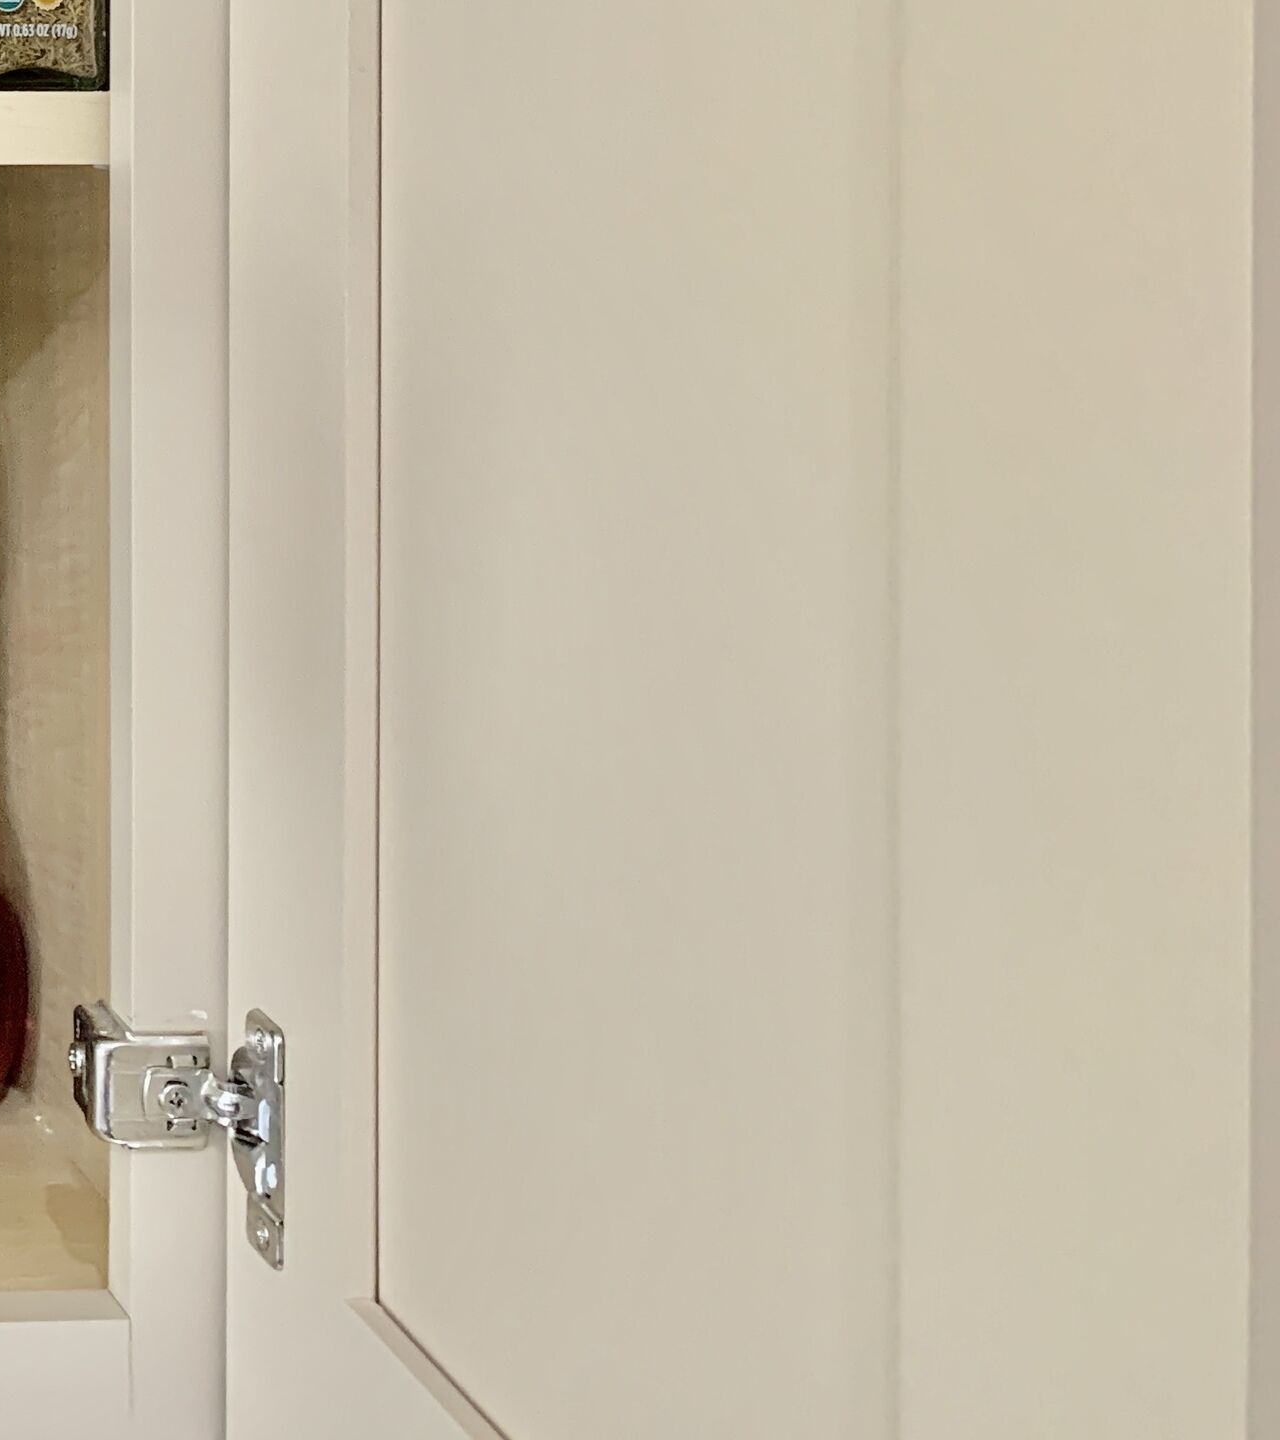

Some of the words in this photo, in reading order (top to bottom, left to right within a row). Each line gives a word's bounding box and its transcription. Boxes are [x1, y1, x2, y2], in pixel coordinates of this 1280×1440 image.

[13, 24, 34, 37] 0.63
[36, 24, 49, 37] OZ
[52, 24, 78, 39] (17g)
